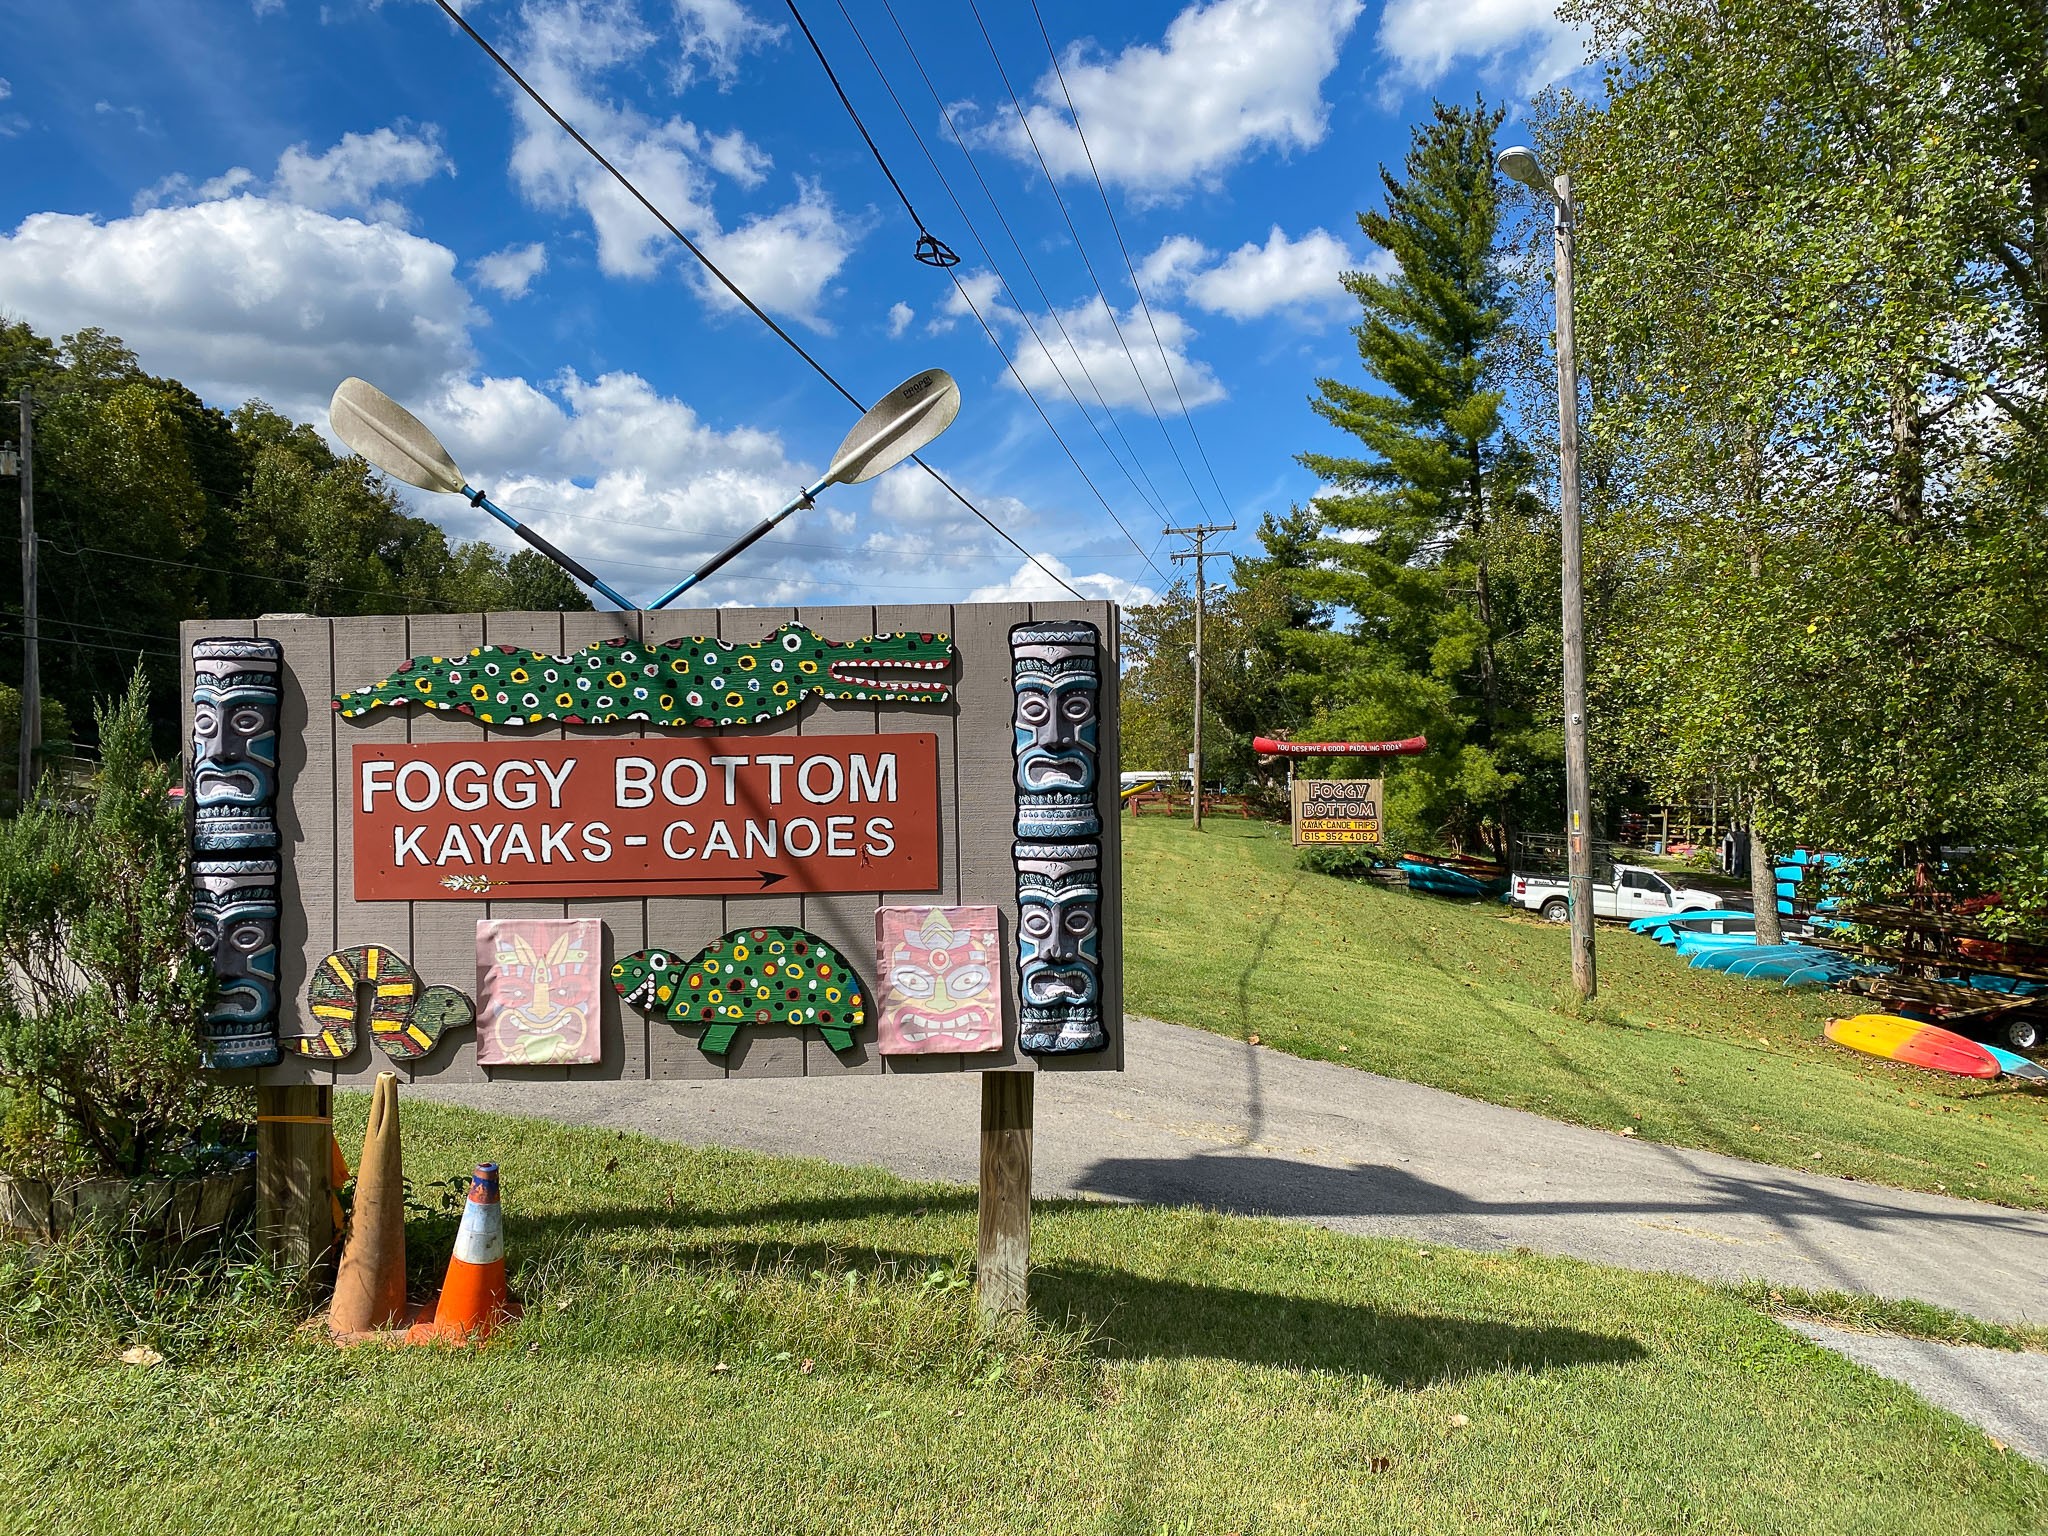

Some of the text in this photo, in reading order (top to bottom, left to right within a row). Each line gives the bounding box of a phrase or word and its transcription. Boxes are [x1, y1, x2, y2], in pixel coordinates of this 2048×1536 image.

[1277, 743, 1290, 752] YOU
[1291, 744, 1321, 753] DESERVE
[1382, 743, 1402, 751] TODAY
[362, 753, 897, 814] FOGGY BOTTOM
[1310, 783, 1369, 800] FOGGY
[1304, 803, 1376, 818] BOTTOM
[1301, 821, 1351, 829] KAYAK-CANOE
[1304, 832, 1375, 841] 615-952-4062
